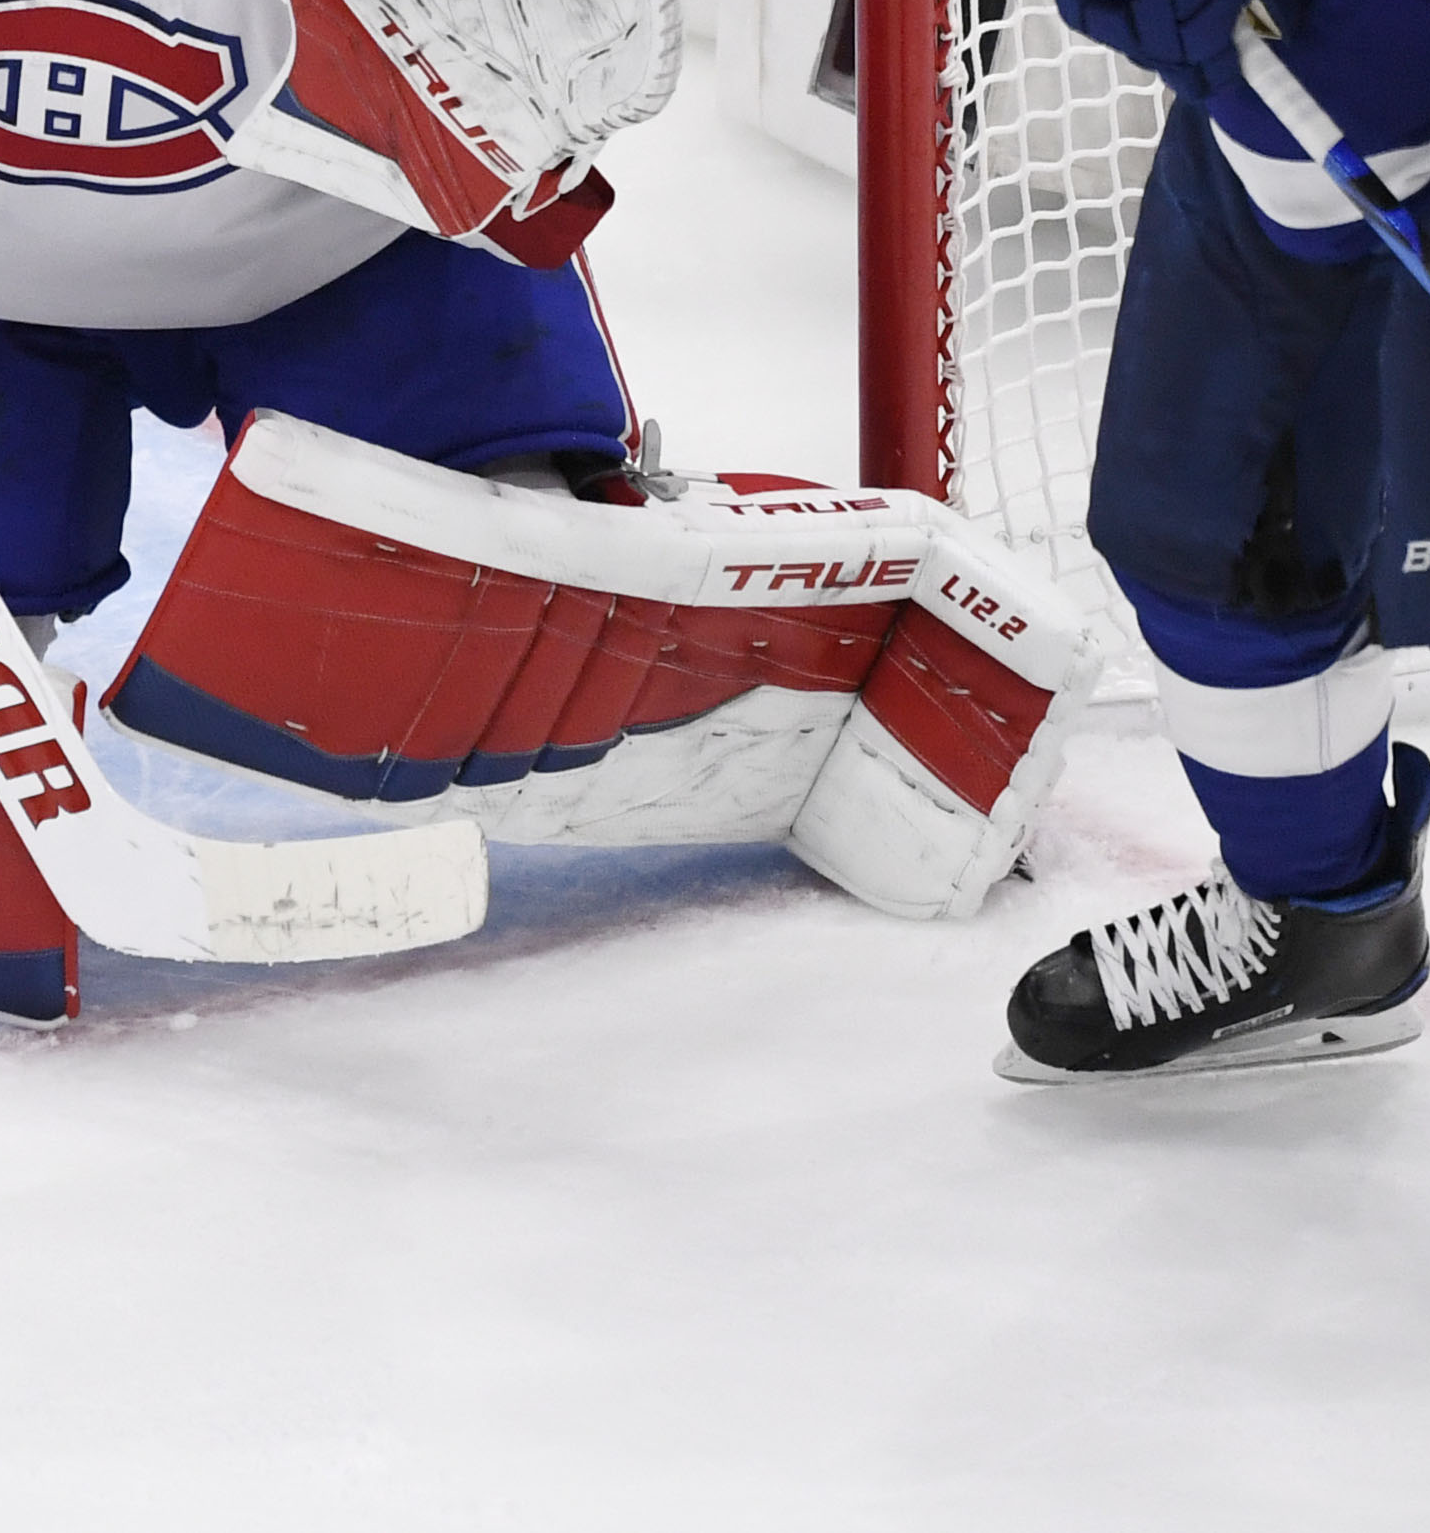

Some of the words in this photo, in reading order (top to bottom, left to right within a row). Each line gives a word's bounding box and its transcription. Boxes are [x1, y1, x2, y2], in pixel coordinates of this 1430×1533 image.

[378, 6, 524, 174] TRUE
[708, 496, 890, 520] TRUE
[722, 556, 921, 594] TRUE
[940, 573, 1030, 643] L12.2
